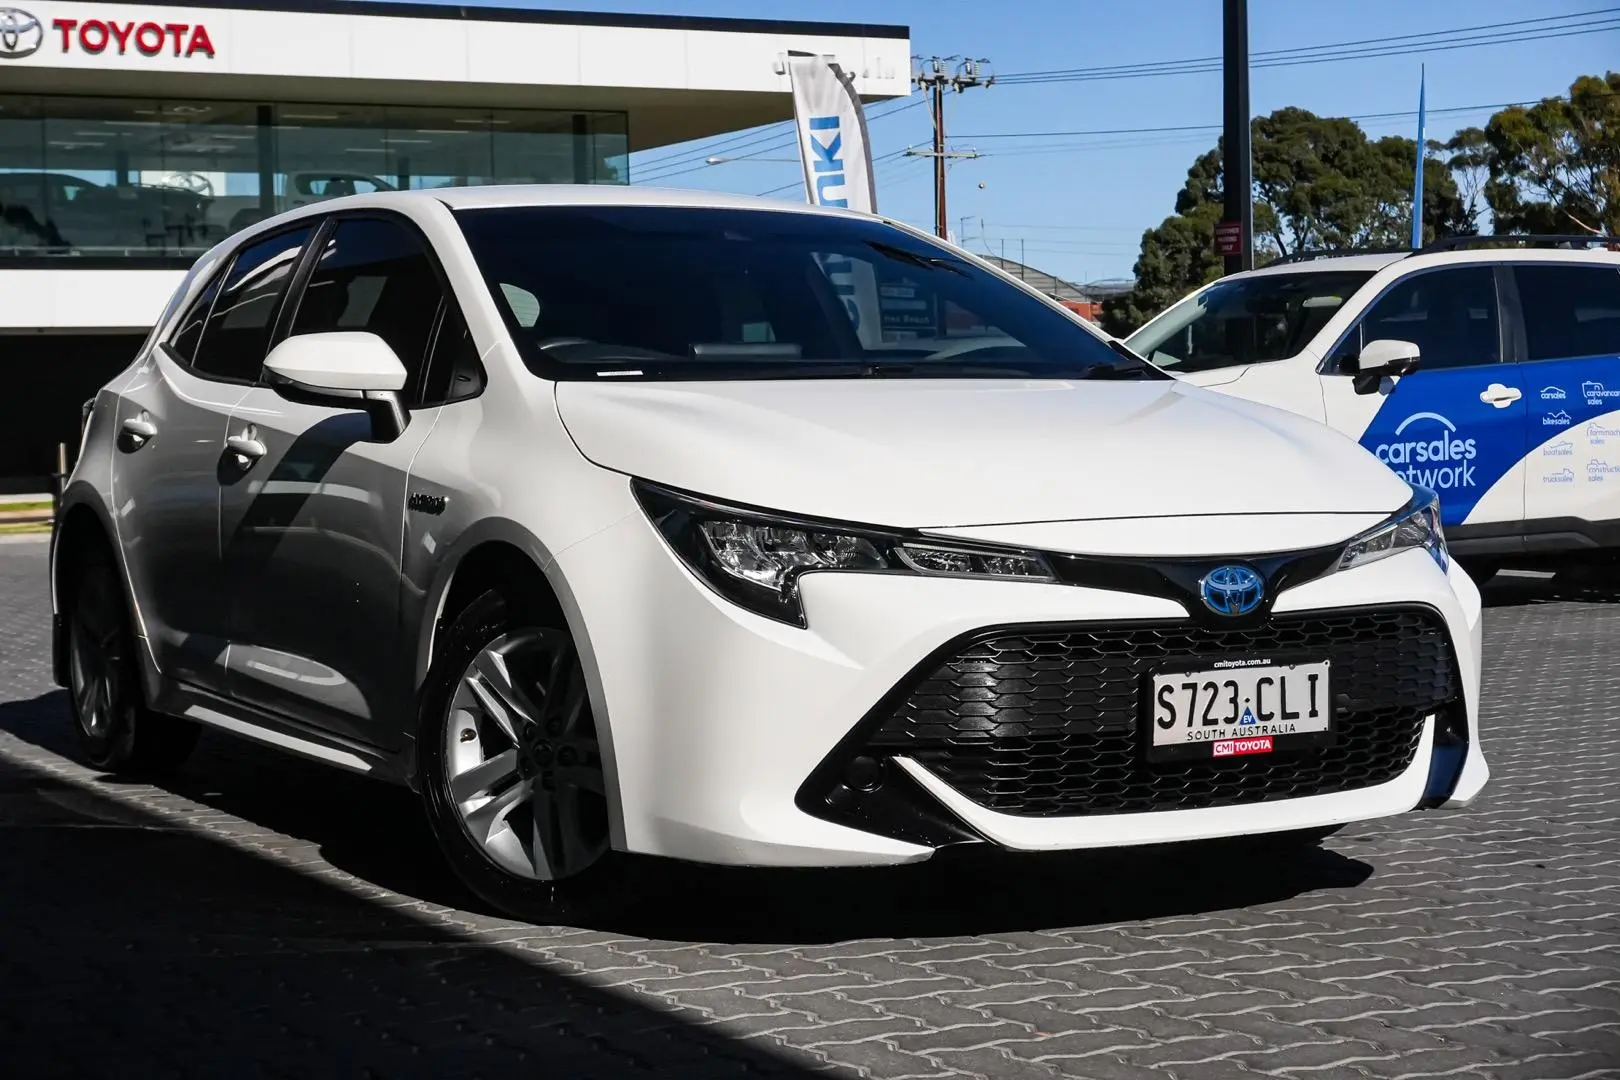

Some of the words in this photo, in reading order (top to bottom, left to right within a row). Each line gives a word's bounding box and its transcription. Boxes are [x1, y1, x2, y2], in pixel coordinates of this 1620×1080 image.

[53, 19, 215, 58] TOYOTA
[1541, 391, 1566, 399] carsales
[1587, 397, 1603, 405] sales
[1542, 416, 1570, 425] bikesales
[1375, 430, 1477, 464] carsales
[1396, 459, 1476, 488] twork
[1542, 474, 1573, 483] trucksales
[1213, 658, 1271, 669] cmitoyota.com.au
[1243, 715, 1254, 724] EV
[1187, 729, 1226, 741] SOUTH
[1231, 723, 1296, 737] AUSTRALIA
[1215, 742, 1234, 754] CMI
[1234, 739, 1272, 752] TOYOTA
